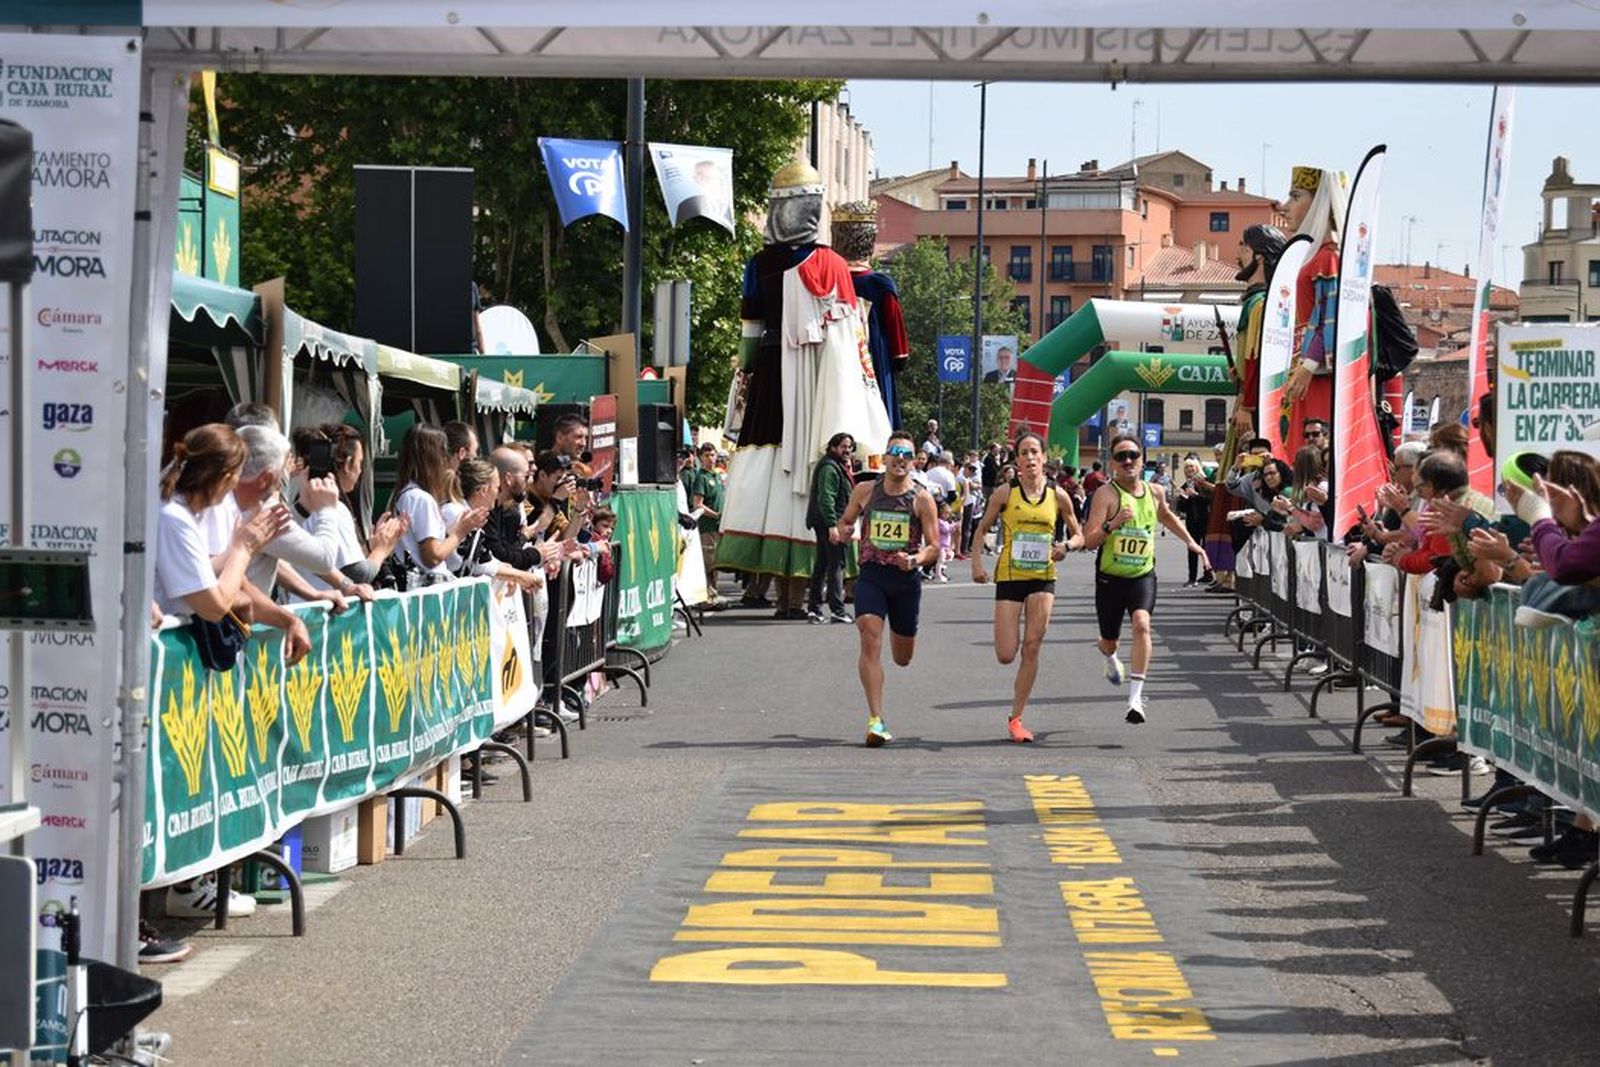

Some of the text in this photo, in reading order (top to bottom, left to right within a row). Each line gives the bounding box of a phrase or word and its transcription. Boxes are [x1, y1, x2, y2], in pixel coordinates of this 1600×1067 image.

[7, 65, 112, 83] FUNDACION
[7, 80, 112, 98] CAJA RURAL
[1186, 329, 1202, 341] DE
[944, 348, 965, 356] VOTA
[1515, 350, 1596, 378] TERMINAR
[1177, 365, 1225, 382] CAJA
[1507, 382, 1600, 410] LA CARRERA
[43, 402, 93, 430] gaza
[1515, 414, 1536, 442] EN
[874, 522, 903, 540] 124
[1120, 538, 1149, 556] 107
[649, 800, 1008, 988] PIDEPAR
[1083, 950, 1218, 1041] REFORMA
